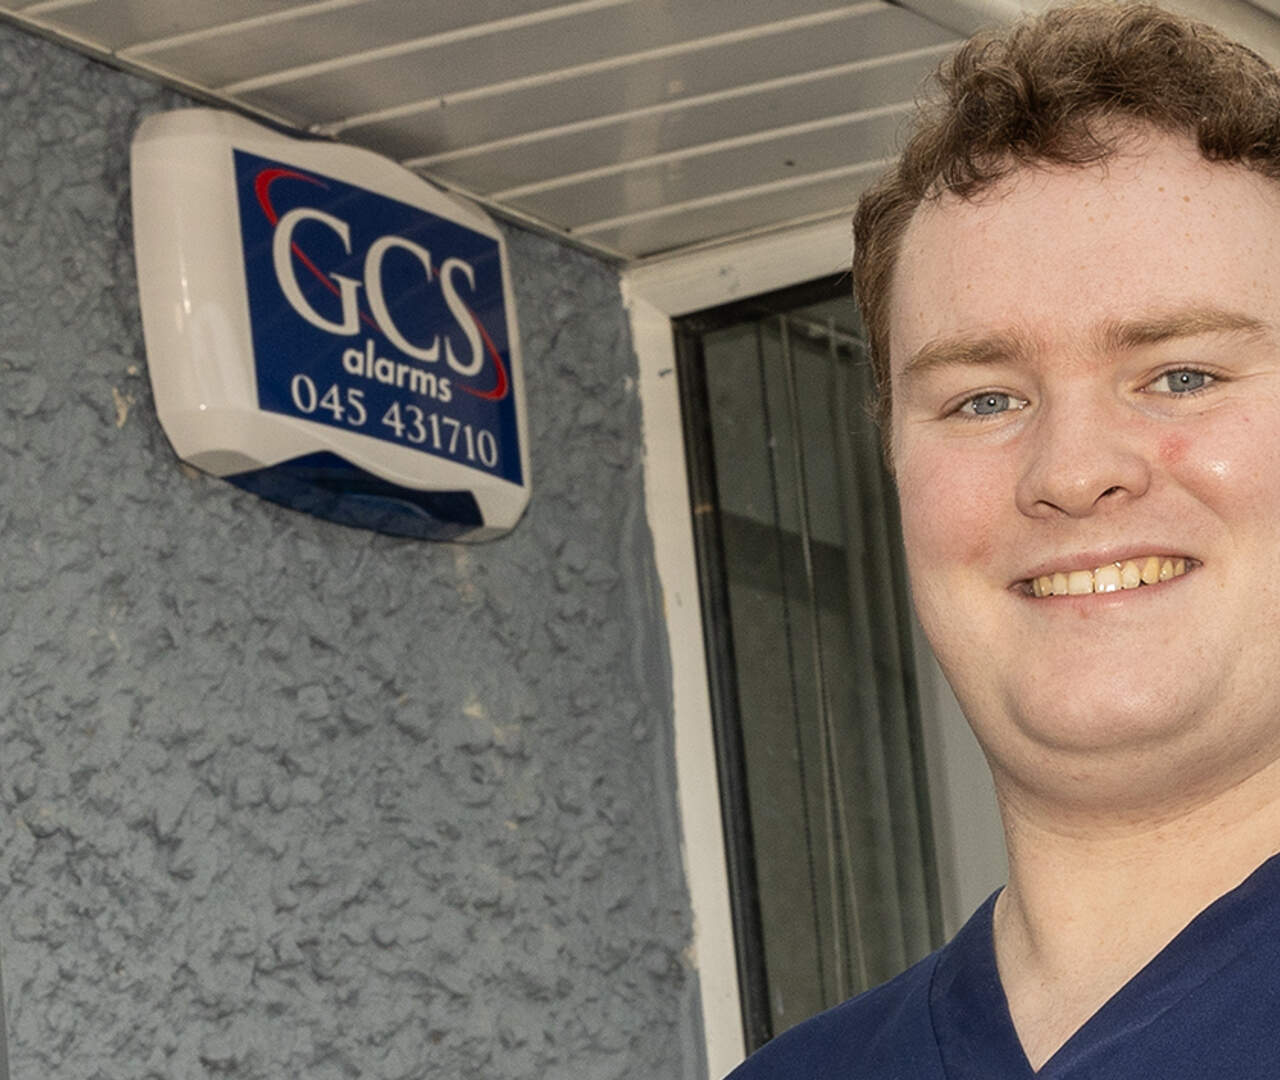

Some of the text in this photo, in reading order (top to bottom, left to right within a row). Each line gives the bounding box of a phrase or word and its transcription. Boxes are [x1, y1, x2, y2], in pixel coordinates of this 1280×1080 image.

[273, 208, 484, 376] GCS
[342, 340, 452, 402] alarms
[291, 375, 498, 468] 045 431710
